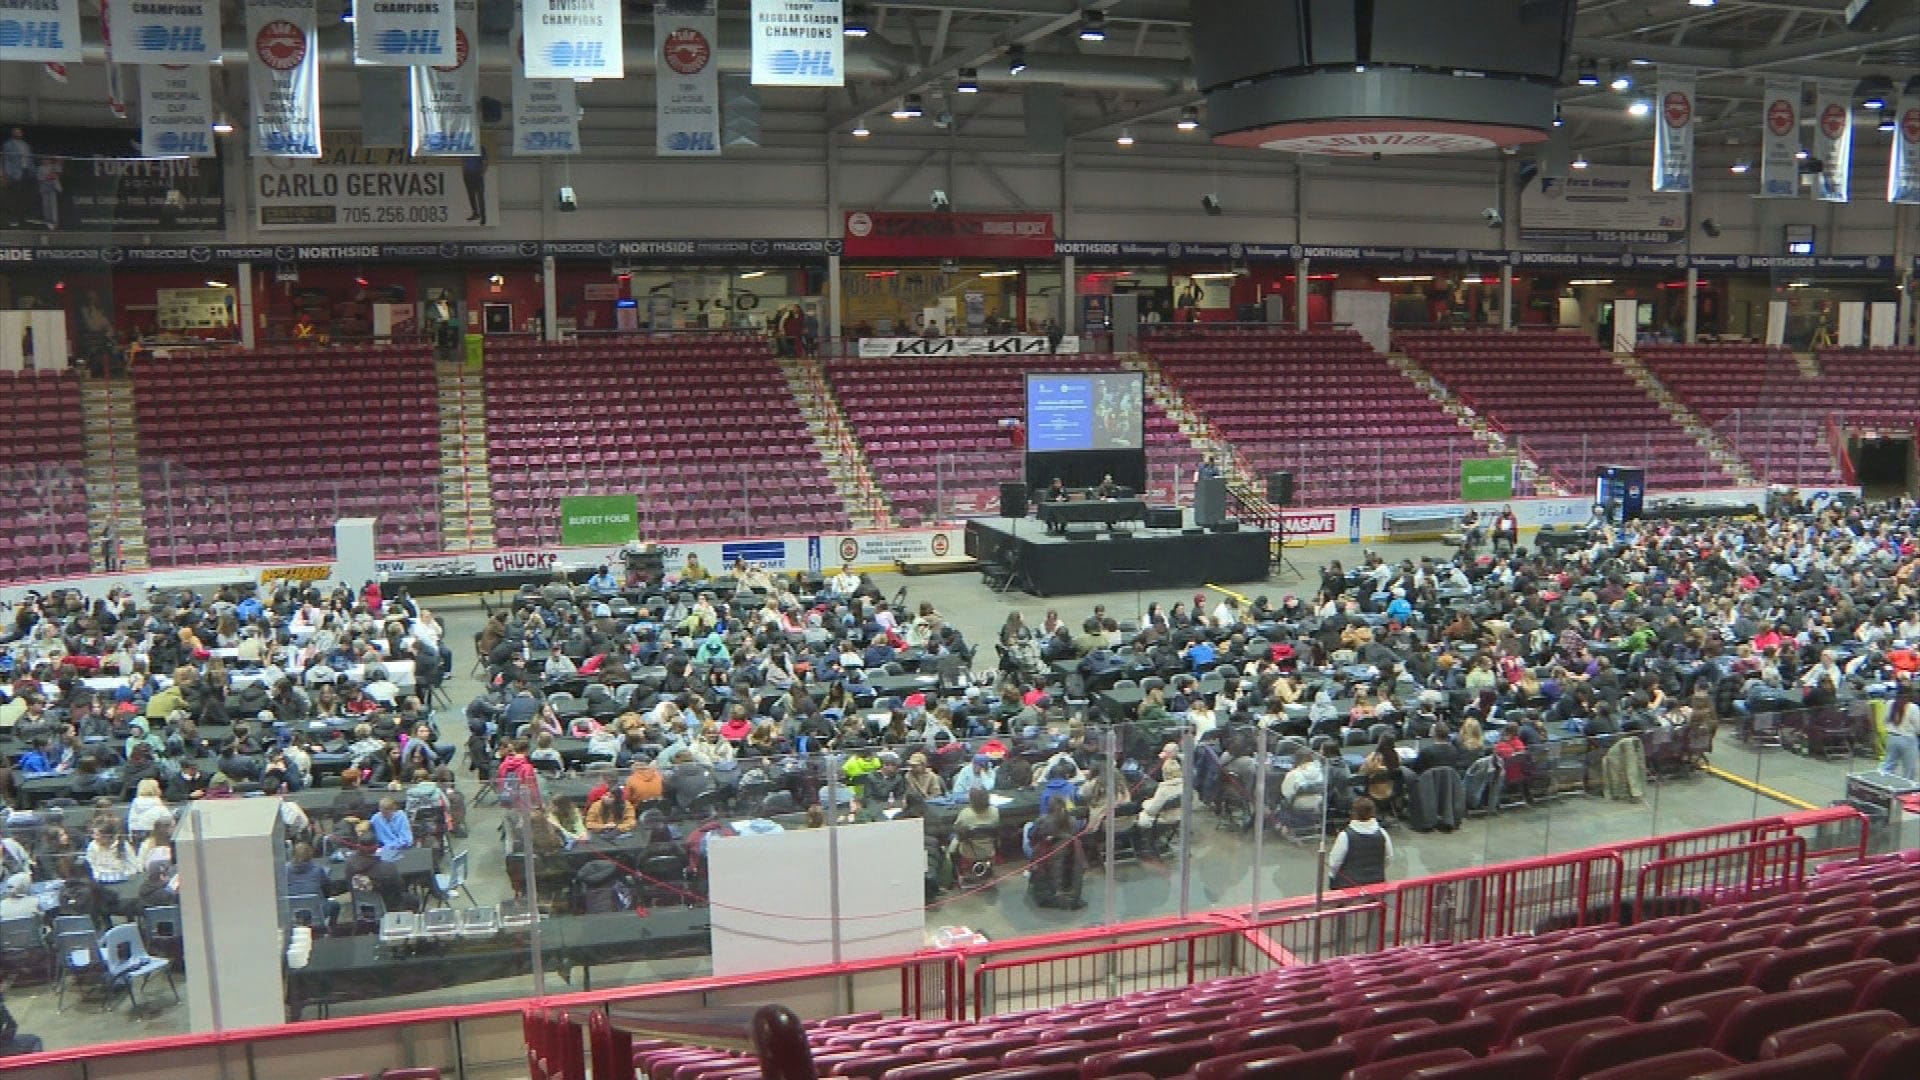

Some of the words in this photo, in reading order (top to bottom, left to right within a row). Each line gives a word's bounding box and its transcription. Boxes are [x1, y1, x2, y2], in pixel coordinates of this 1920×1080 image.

[131, 2, 203, 14] CHAMPIONS
[373, 3, 440, 14] CHAMPIONS
[542, 14, 603, 26] CHAMPIONS
[133, 25, 206, 51] OHL
[765, 26, 833, 38] CHAMPIONS
[375, 29, 442, 54] OHL
[540, 41, 606, 67] OHL
[764, 49, 835, 76] OHL
[260, 173, 338, 197] CARLO
[347, 171, 444, 196] GERVASI
[343, 206, 448, 224] 705.256.0083
[298, 246, 380, 259] NORTHSIDE
[619, 241, 695, 253] NORTHSIDE
[1055, 243, 1119, 255] NORTHSIDE
[1304, 246, 1360, 258] NORTHSIDE
[1522, 253, 1578, 264] NORTHSIDE
[1752, 256, 1815, 267] NORTHSIDE
[895, 339, 954, 355] KIA
[988, 337, 1046, 353] KIA
[568, 515, 602, 525] BUFFET
[604, 513, 630, 523] FOUR
